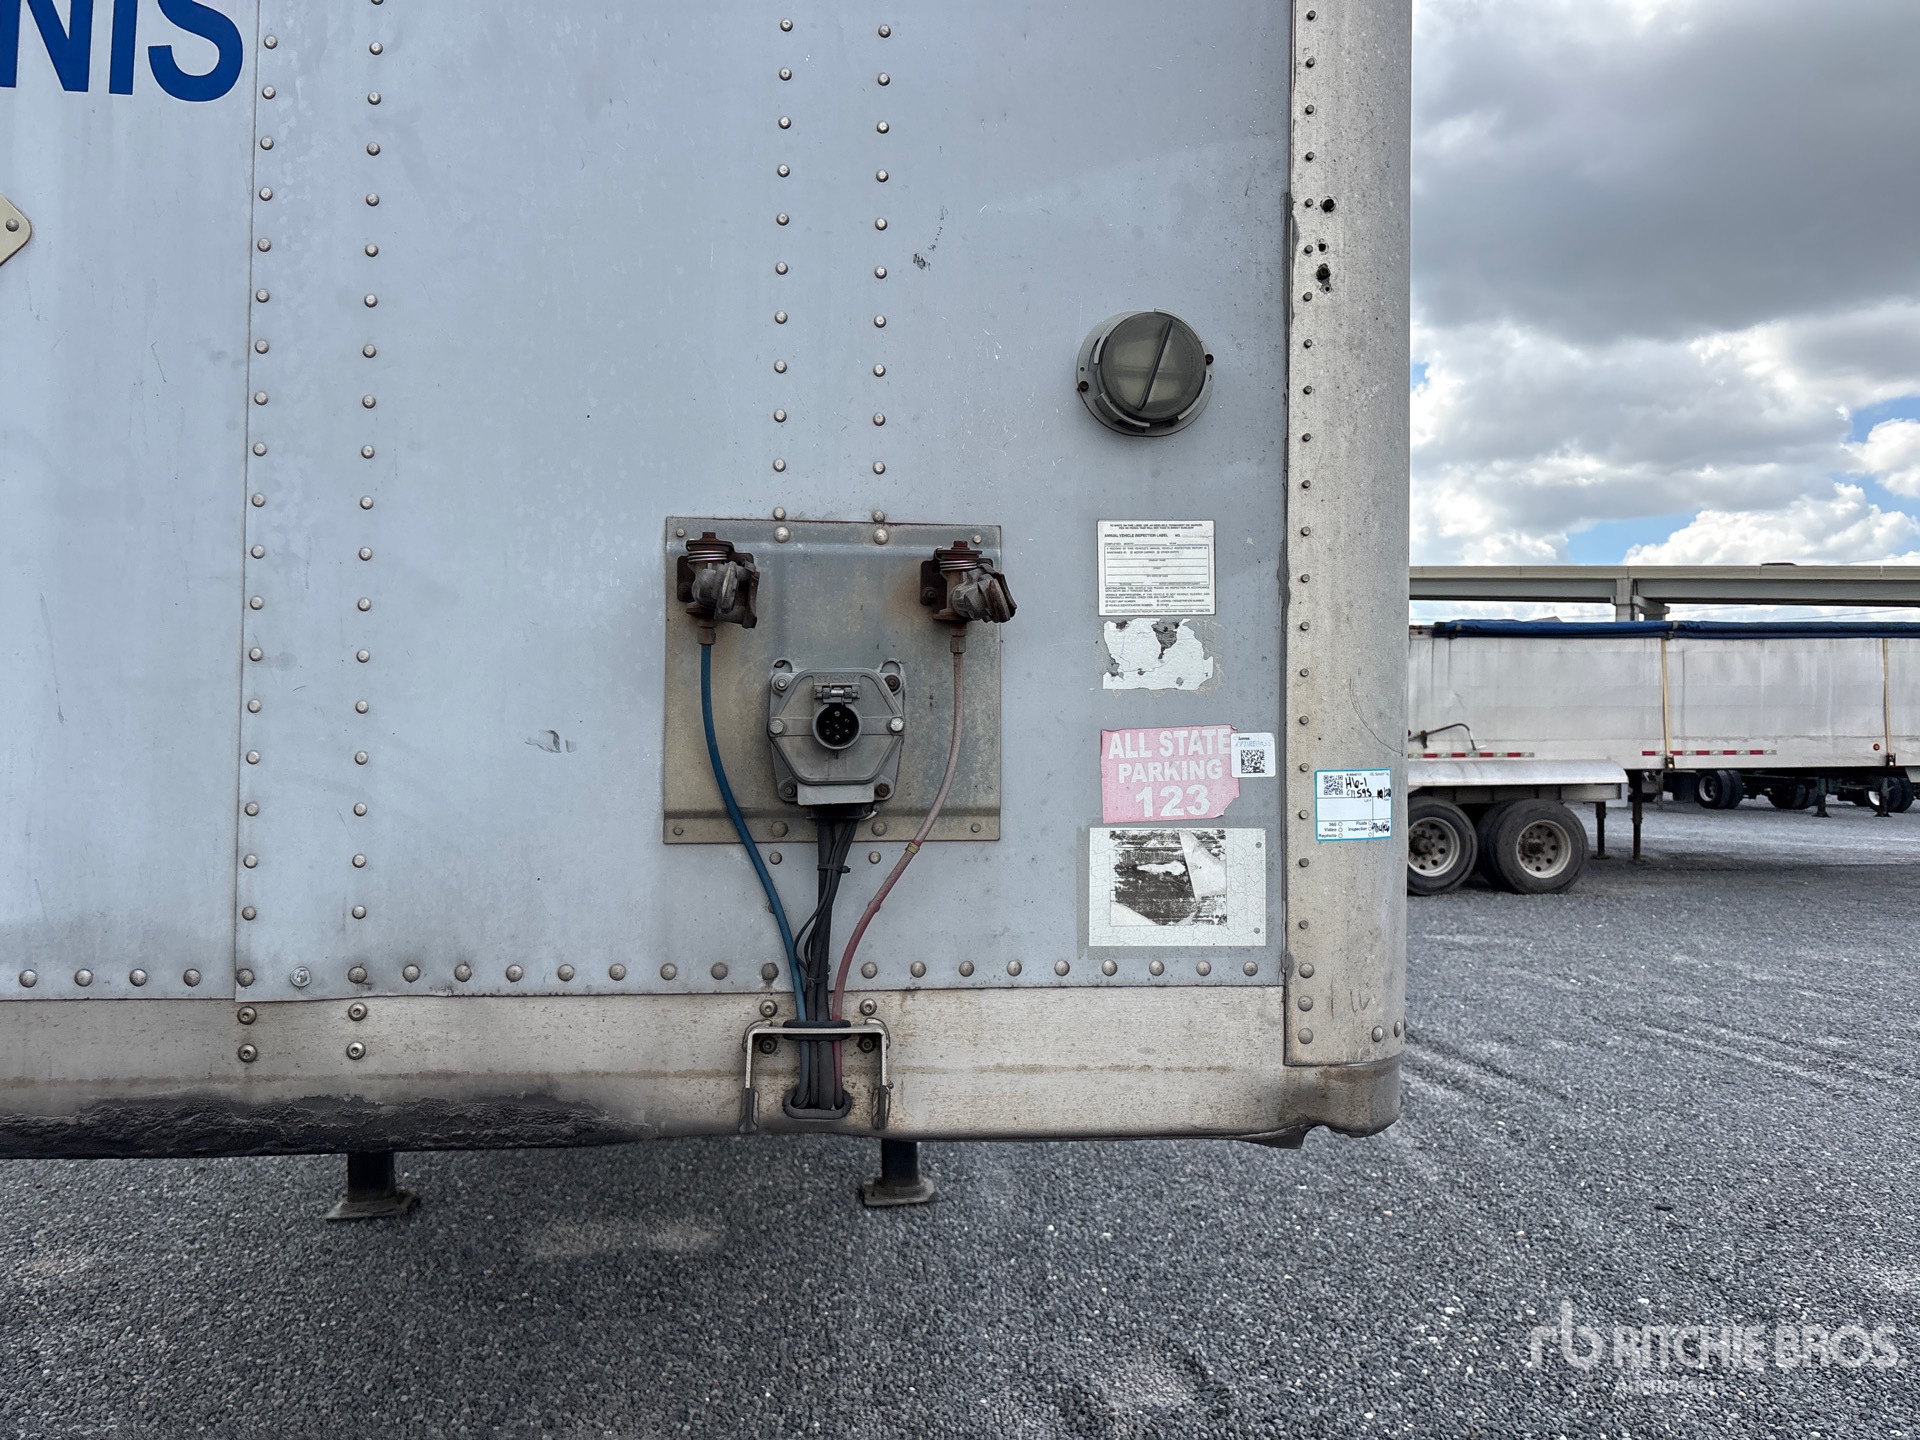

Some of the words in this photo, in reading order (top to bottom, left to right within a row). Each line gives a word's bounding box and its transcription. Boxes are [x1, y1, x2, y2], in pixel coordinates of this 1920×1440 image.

[1108, 732, 1152, 759] ALL
[1159, 728, 1231, 756] STATE
[1118, 759, 1223, 783] PARKING
[1135, 784, 1210, 818] 123
